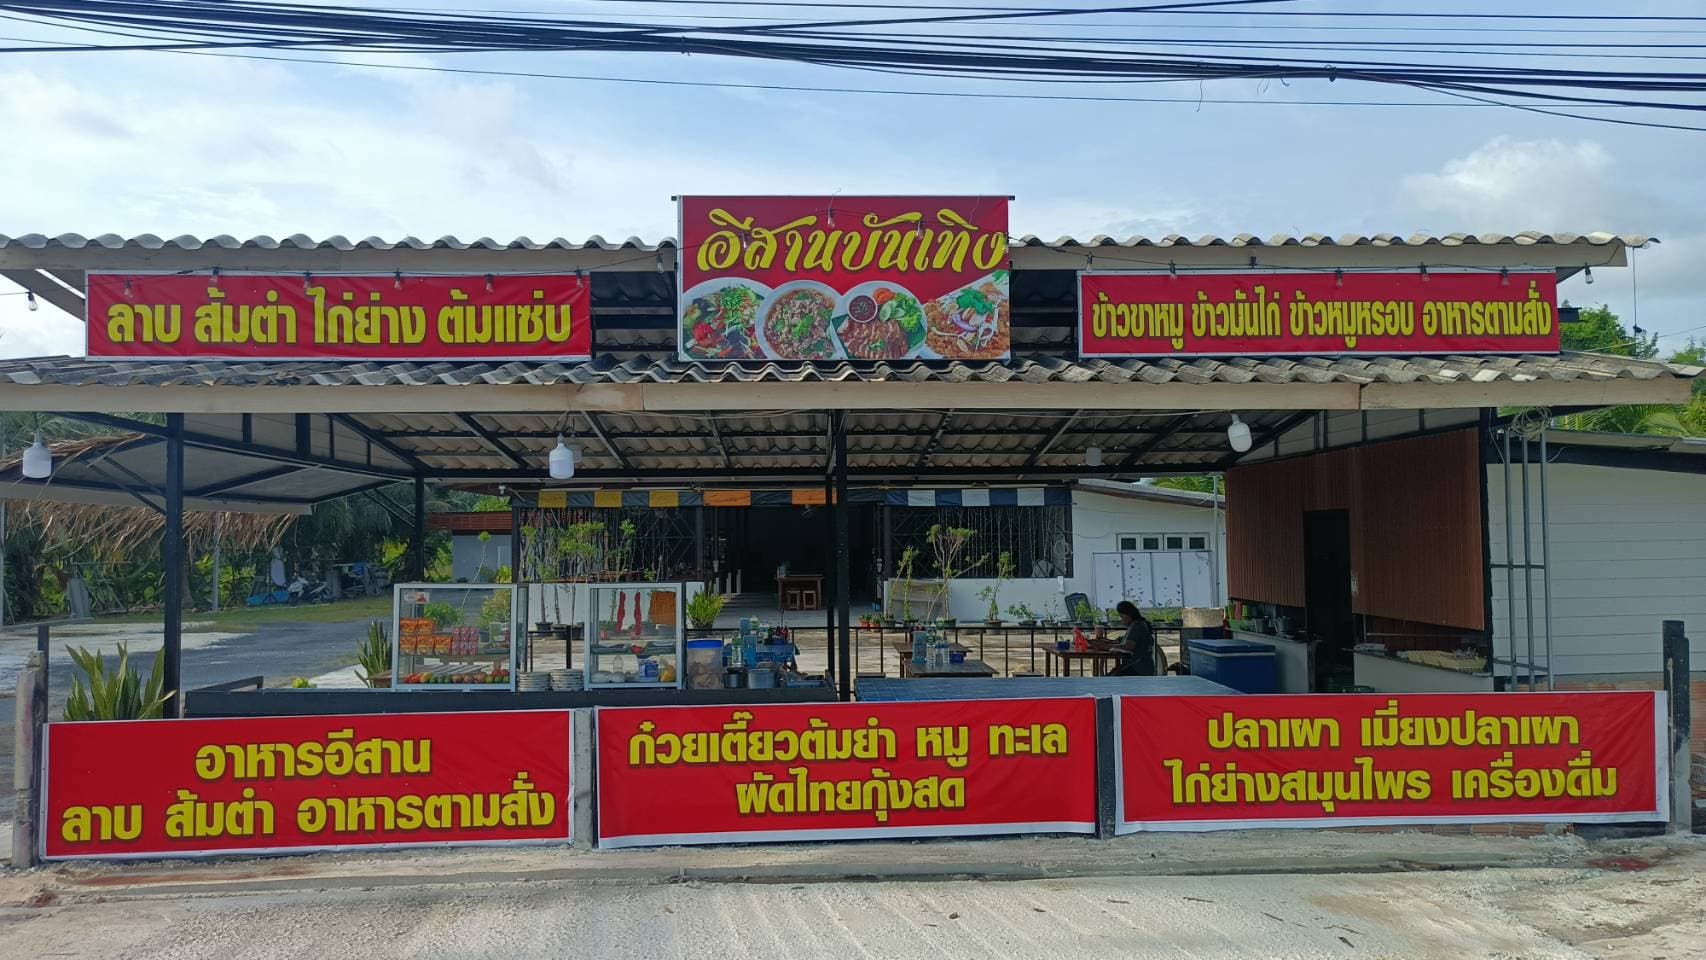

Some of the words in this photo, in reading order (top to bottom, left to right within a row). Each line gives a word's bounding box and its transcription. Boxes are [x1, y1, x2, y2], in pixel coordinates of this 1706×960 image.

[697, 208, 1006, 273] อีสานบันเทิง
[107, 303, 181, 343] ลาบ
[194, 287, 297, 344] ส้มตำ
[306, 287, 426, 344] ไก่ย่าง
[438, 289, 571, 344] ต้มแซ่บ
[1093, 291, 1184, 350] ข้าวขาหมู
[1192, 285, 1281, 337] ข้าวมันไก่
[1290, 290, 1415, 349] ข้าวหมูหรอบ
[1422, 281, 1552, 336] อาหารตามสั่ง
[629, 711, 896, 765] ก๋วยเตี๊ยวต้มยำ
[917, 726, 969, 768] หมู
[989, 723, 1068, 756] ทะเล
[1207, 712, 1340, 749] ปลาเผา
[1361, 700, 1579, 747] เมี่ยงปลาเผา
[196, 728, 431, 780] อาหารอีสาน
[1163, 757, 1431, 813] ไก่ย่างสมุนไพร
[1451, 750, 1618, 799] เครื่องดื่ม
[62, 804, 142, 842] ลาบ
[165, 787, 274, 838] ส้มตำ
[297, 771, 555, 834] อาหารตามสั่ง
[736, 767, 966, 822] ผัดไทยกุ้งสด
